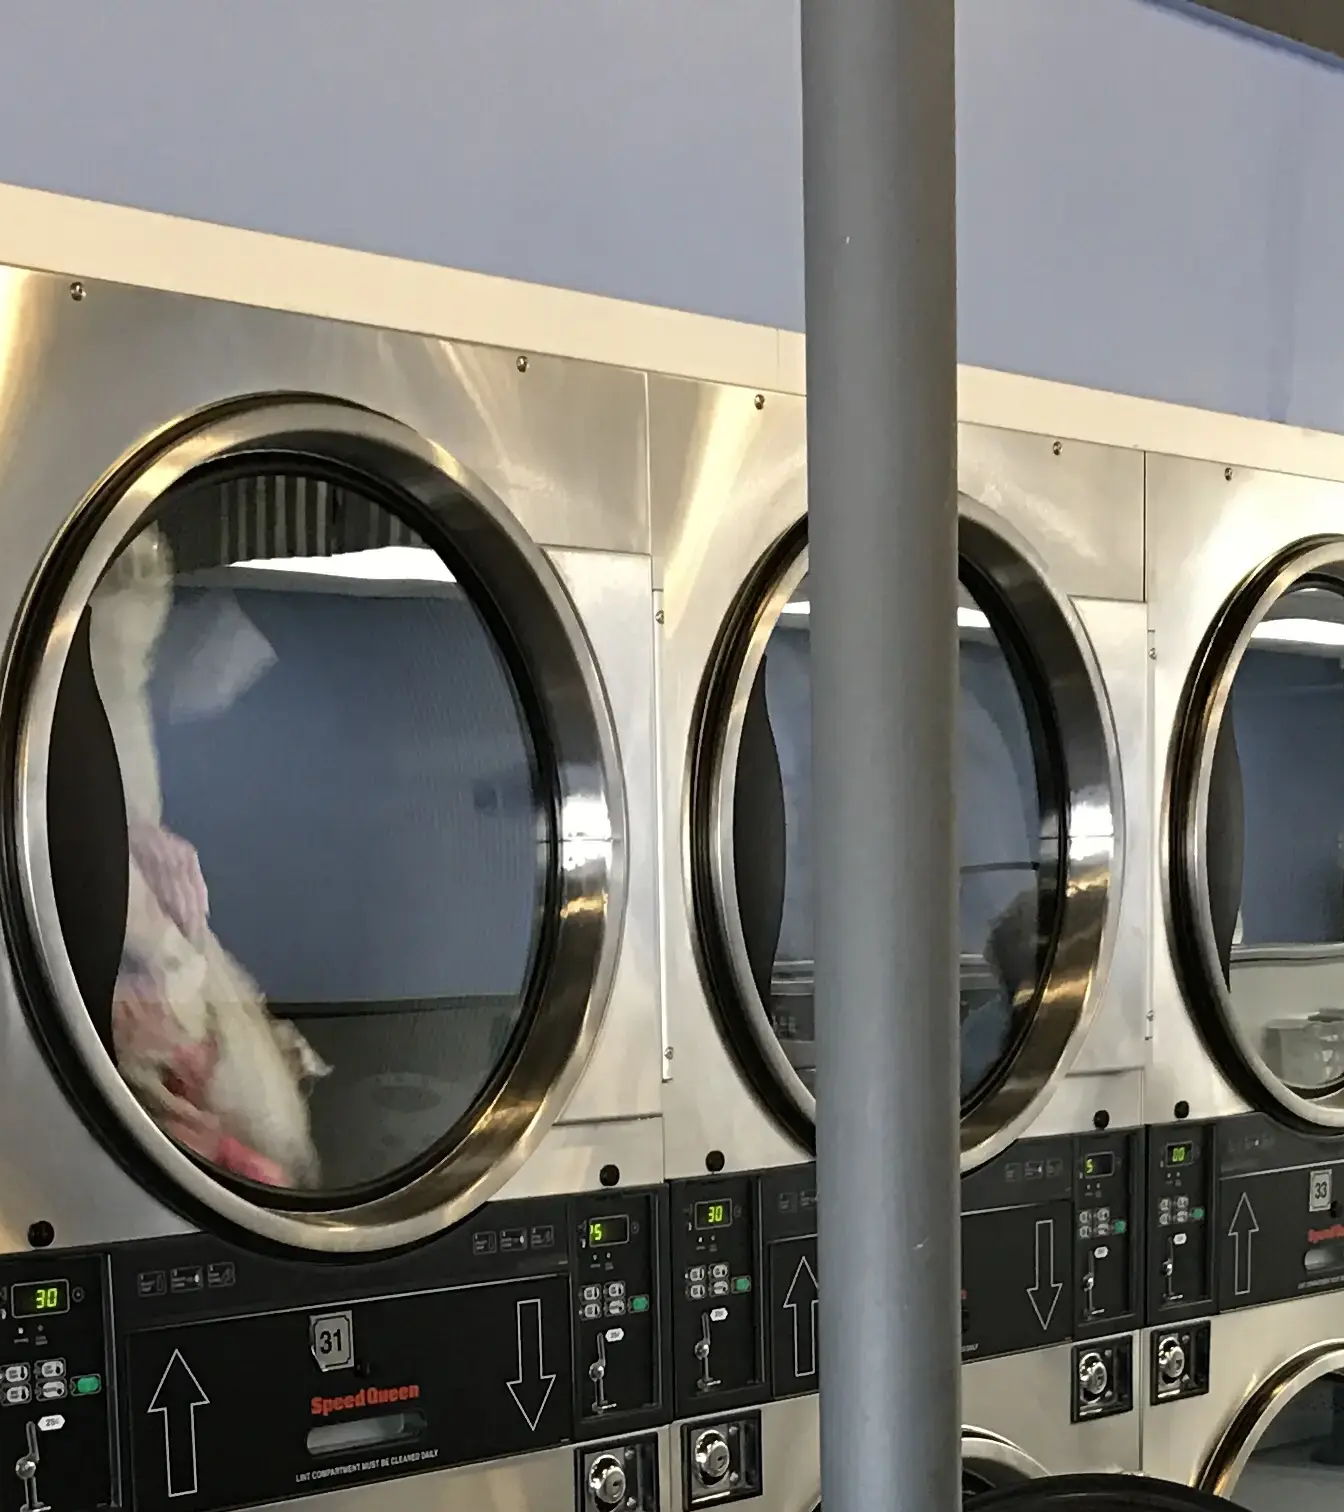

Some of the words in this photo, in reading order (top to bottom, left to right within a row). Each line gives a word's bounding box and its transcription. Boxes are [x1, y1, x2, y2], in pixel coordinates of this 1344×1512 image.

[1314, 1181, 1328, 1199] 33
[708, 1205, 723, 1223] 30
[36, 1288, 58, 1309] 30
[319, 1328, 342, 1354] 31
[311, 1389, 366, 1416] Speed
[366, 1384, 420, 1405] Queen
[311, 1463, 361, 1480] COMPARTMENT
[361, 1459, 380, 1470] MUST
[380, 1457, 390, 1467] BE
[390, 1451, 420, 1465] CLEANED
